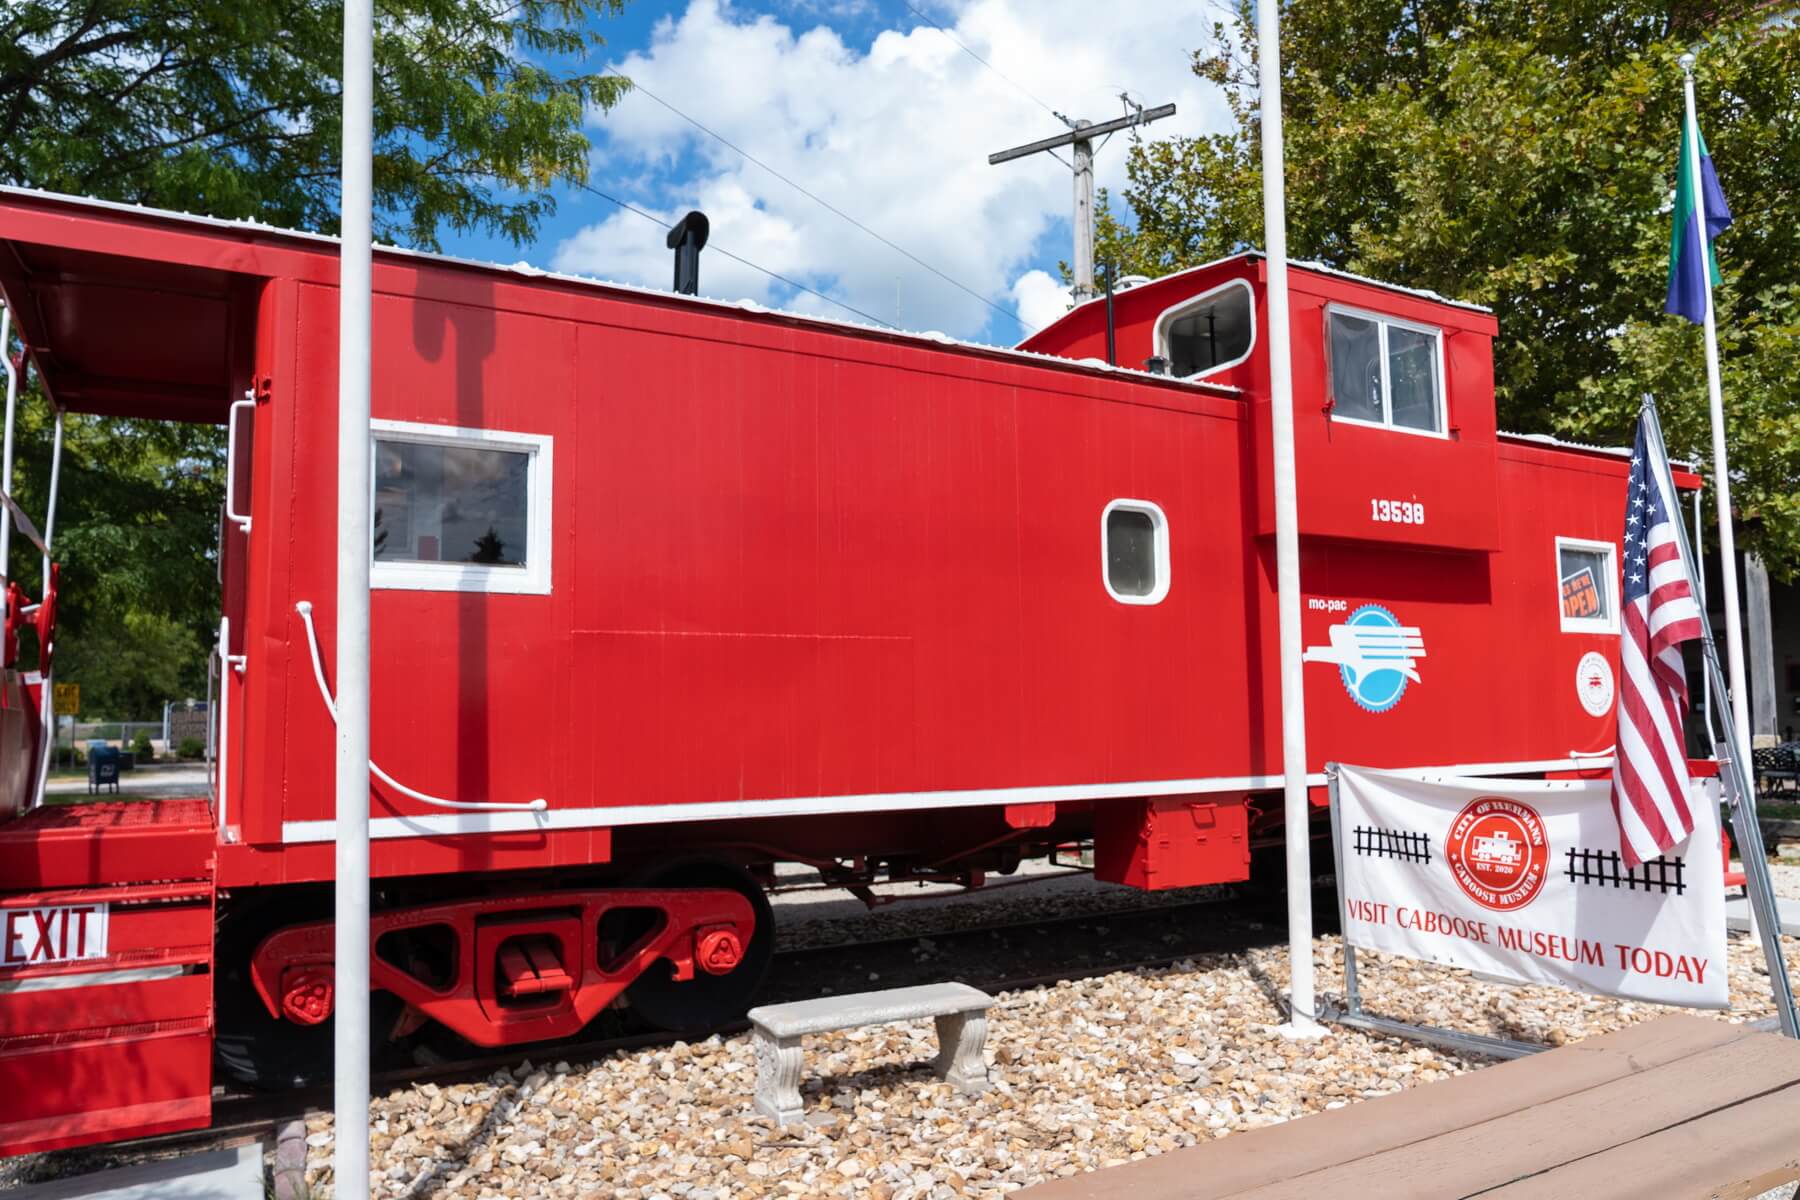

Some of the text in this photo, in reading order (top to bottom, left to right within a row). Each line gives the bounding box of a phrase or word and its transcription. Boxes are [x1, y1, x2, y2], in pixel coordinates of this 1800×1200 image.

[1371, 498, 1425, 525] 13538
[1454, 811, 1476, 841] CITY
[1476, 801, 1491, 814] OF
[1454, 862, 1538, 905] CABOOSE MUSEUM
[1476, 862, 1514, 874] EST. 2020
[4, 906, 96, 963] EXIT
[1347, 898, 1708, 985] VISIT CABOOSE MUSEUM TODAY
